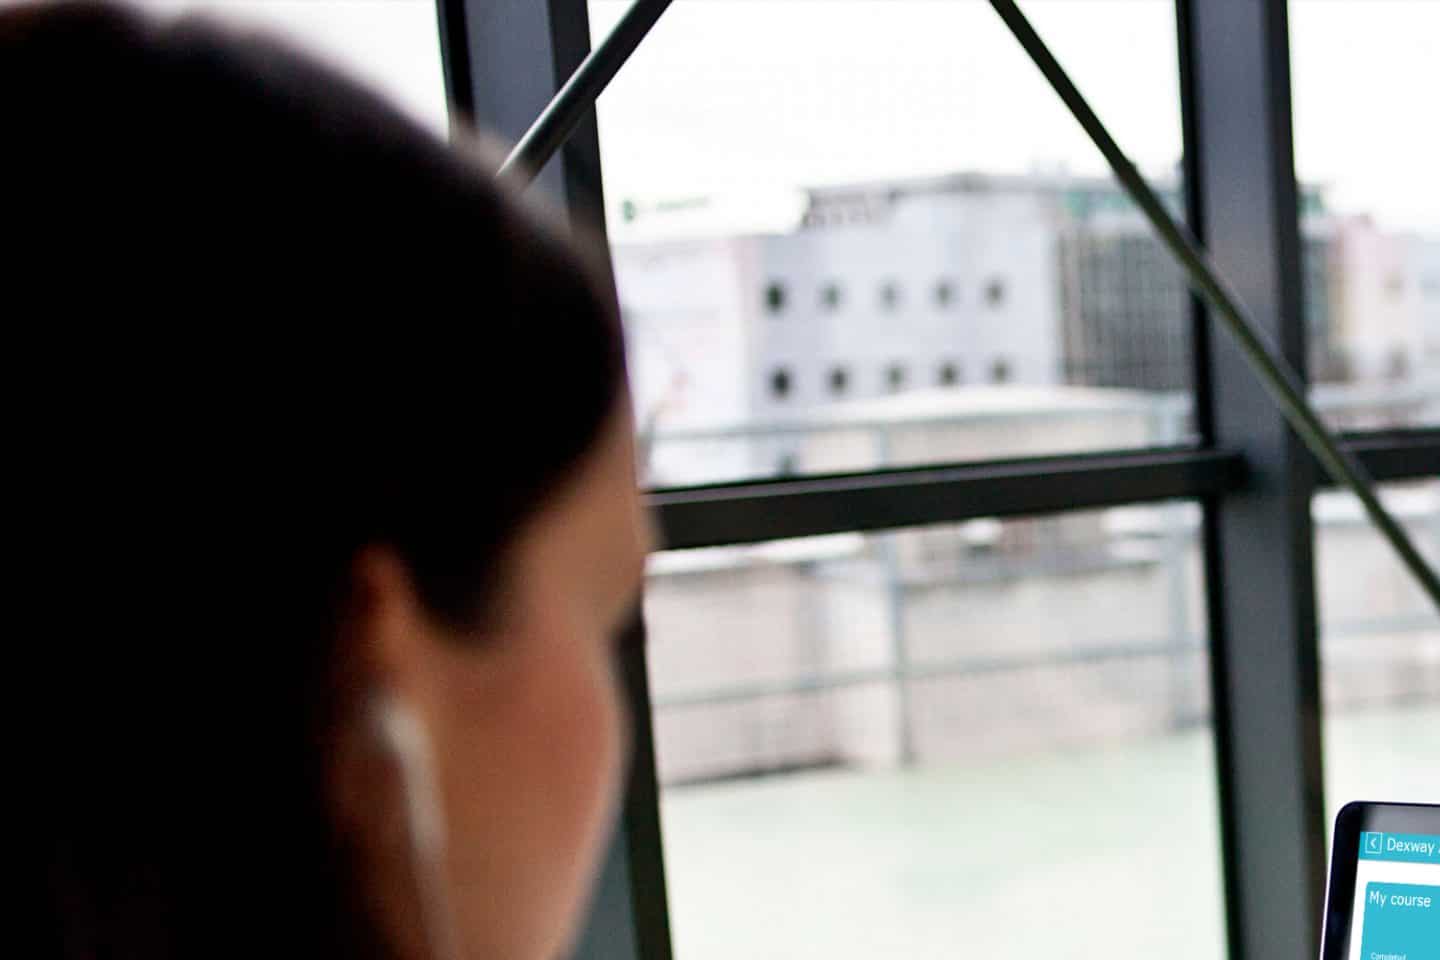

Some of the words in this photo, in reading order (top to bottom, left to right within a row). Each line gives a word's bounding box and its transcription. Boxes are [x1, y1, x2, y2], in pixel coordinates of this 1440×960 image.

[1387, 837, 1436, 856] Dexway
[1369, 890, 1387, 909] My
[1390, 893, 1432, 908] course
